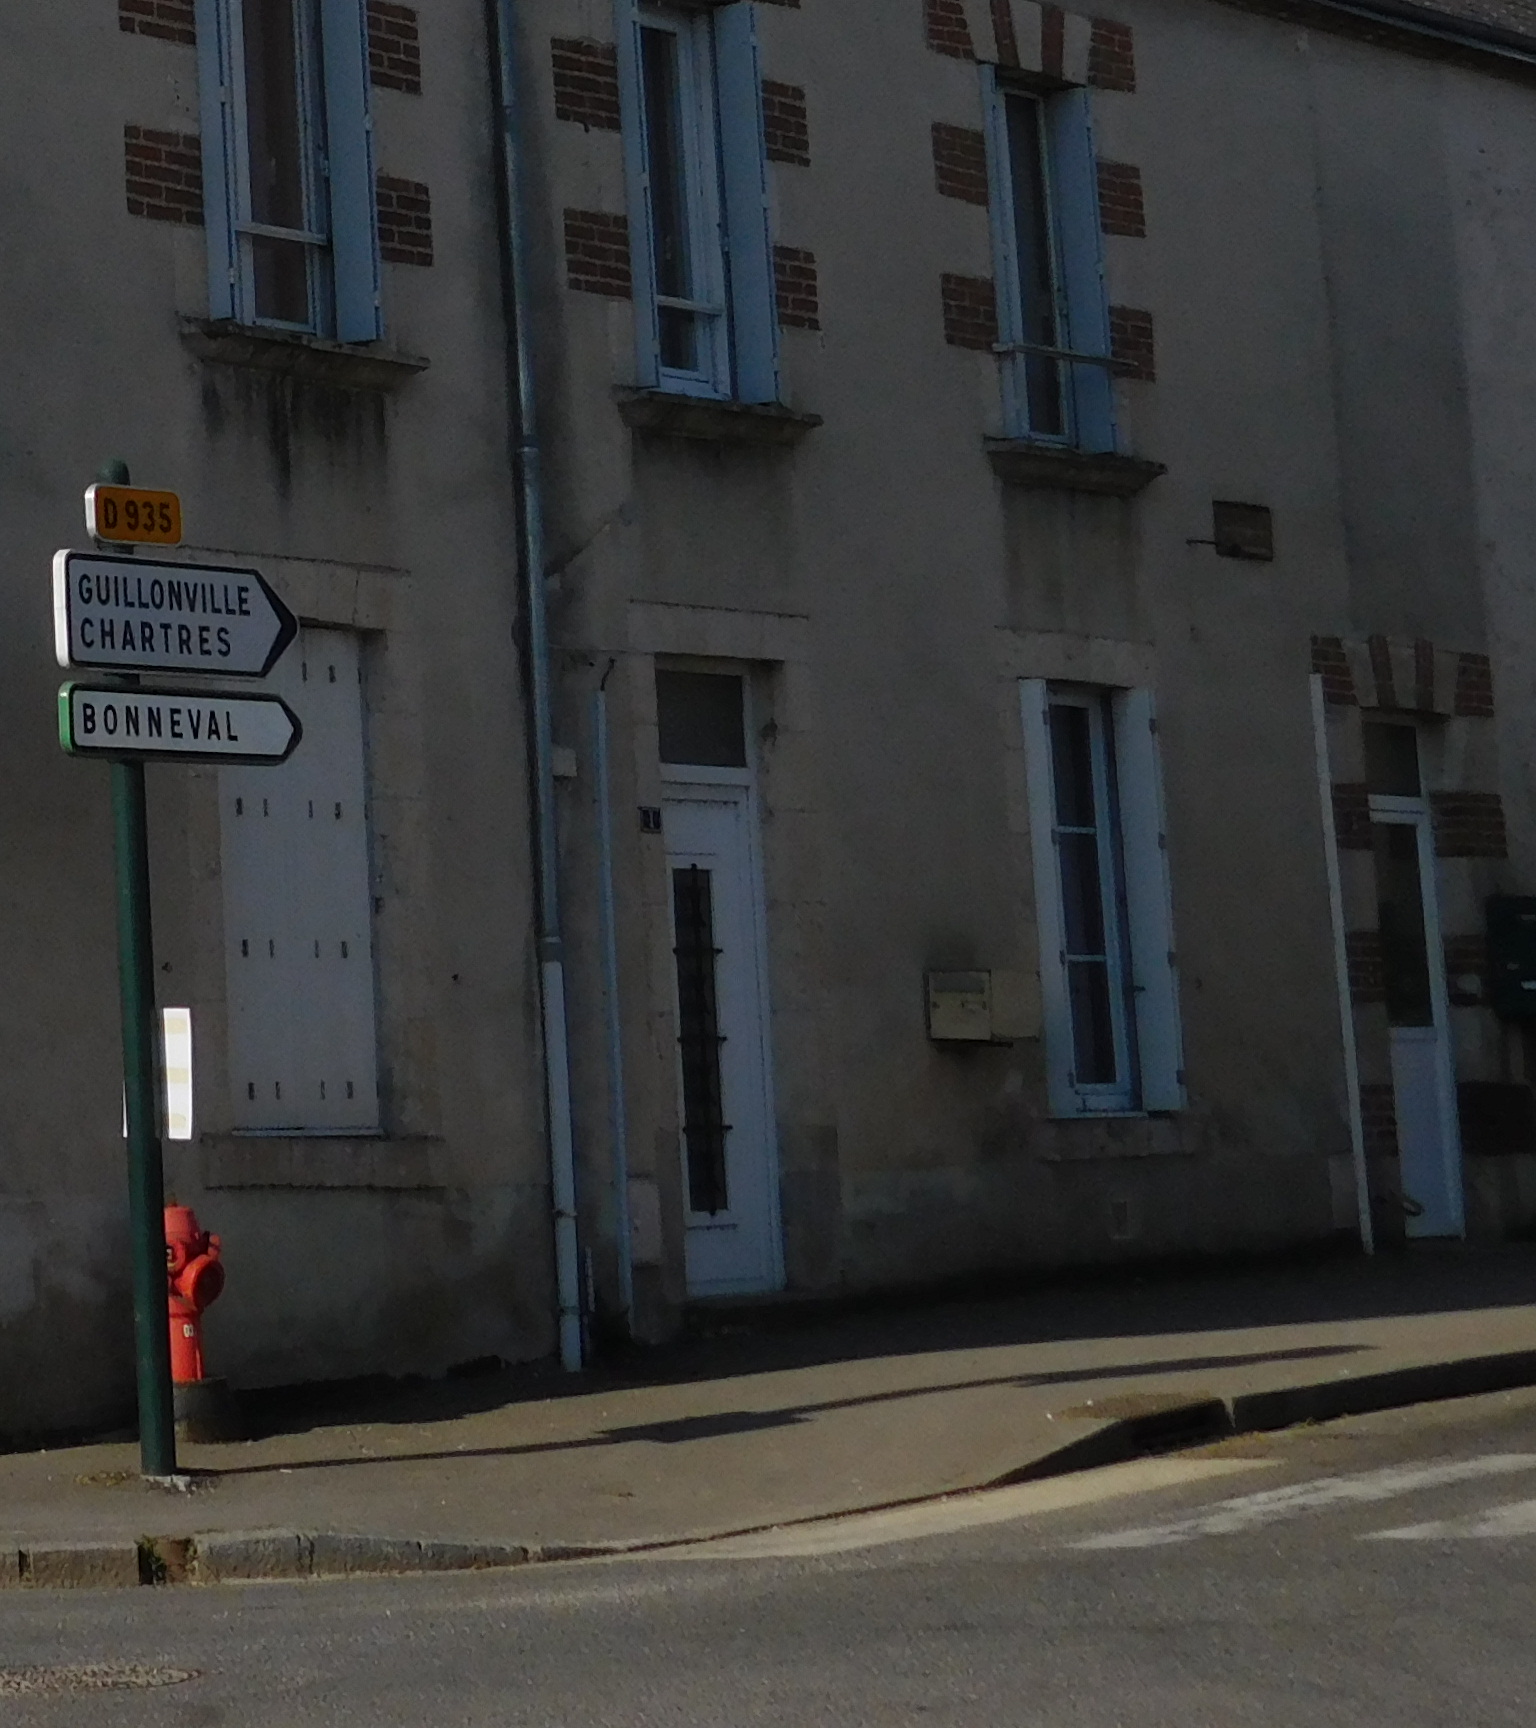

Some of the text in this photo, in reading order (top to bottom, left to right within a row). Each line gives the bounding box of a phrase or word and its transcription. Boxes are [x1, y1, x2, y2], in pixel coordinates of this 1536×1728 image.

[104, 498, 172, 535] D 935
[78, 574, 250, 615] GUILLONVILLE
[80, 618, 231, 657] CHARTRES
[83, 703, 238, 742] BONNEVAL
